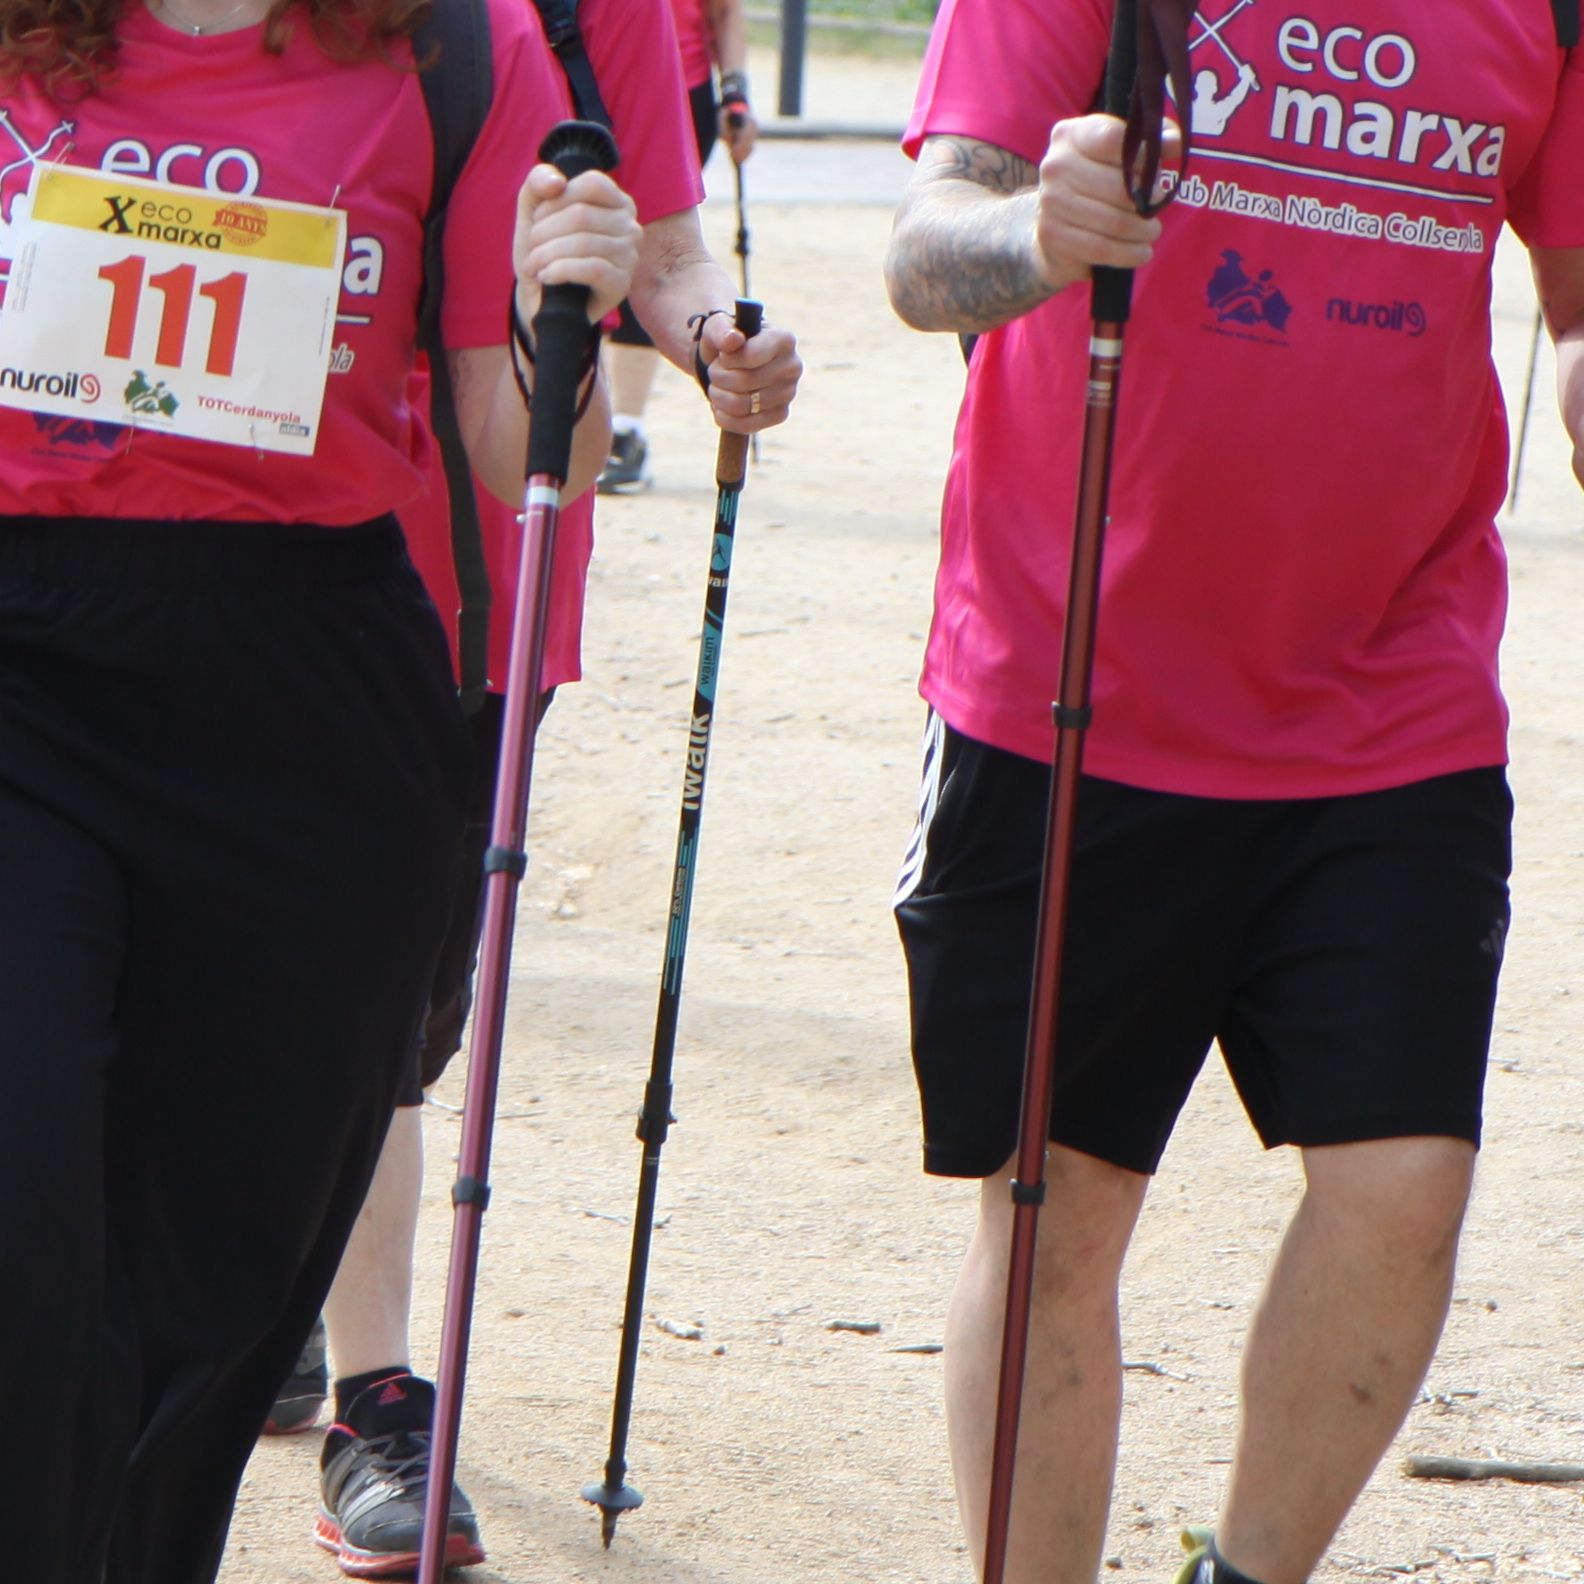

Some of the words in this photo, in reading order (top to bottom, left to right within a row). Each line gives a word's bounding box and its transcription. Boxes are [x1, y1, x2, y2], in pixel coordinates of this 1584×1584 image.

[1277, 16, 1417, 89] eco
[1270, 85, 1506, 178] marxa
[102, 139, 262, 197] eco
[98, 195, 138, 235] X
[140, 201, 193, 225] eco
[137, 221, 223, 250] marxa
[1212, 178, 1283, 221] Marxa
[1285, 195, 1382, 238] Nòrdica
[98, 255, 248, 377] 111
[197, 395, 302, 424] TOTCerdanyola
[682, 712, 712, 810] iwalk
